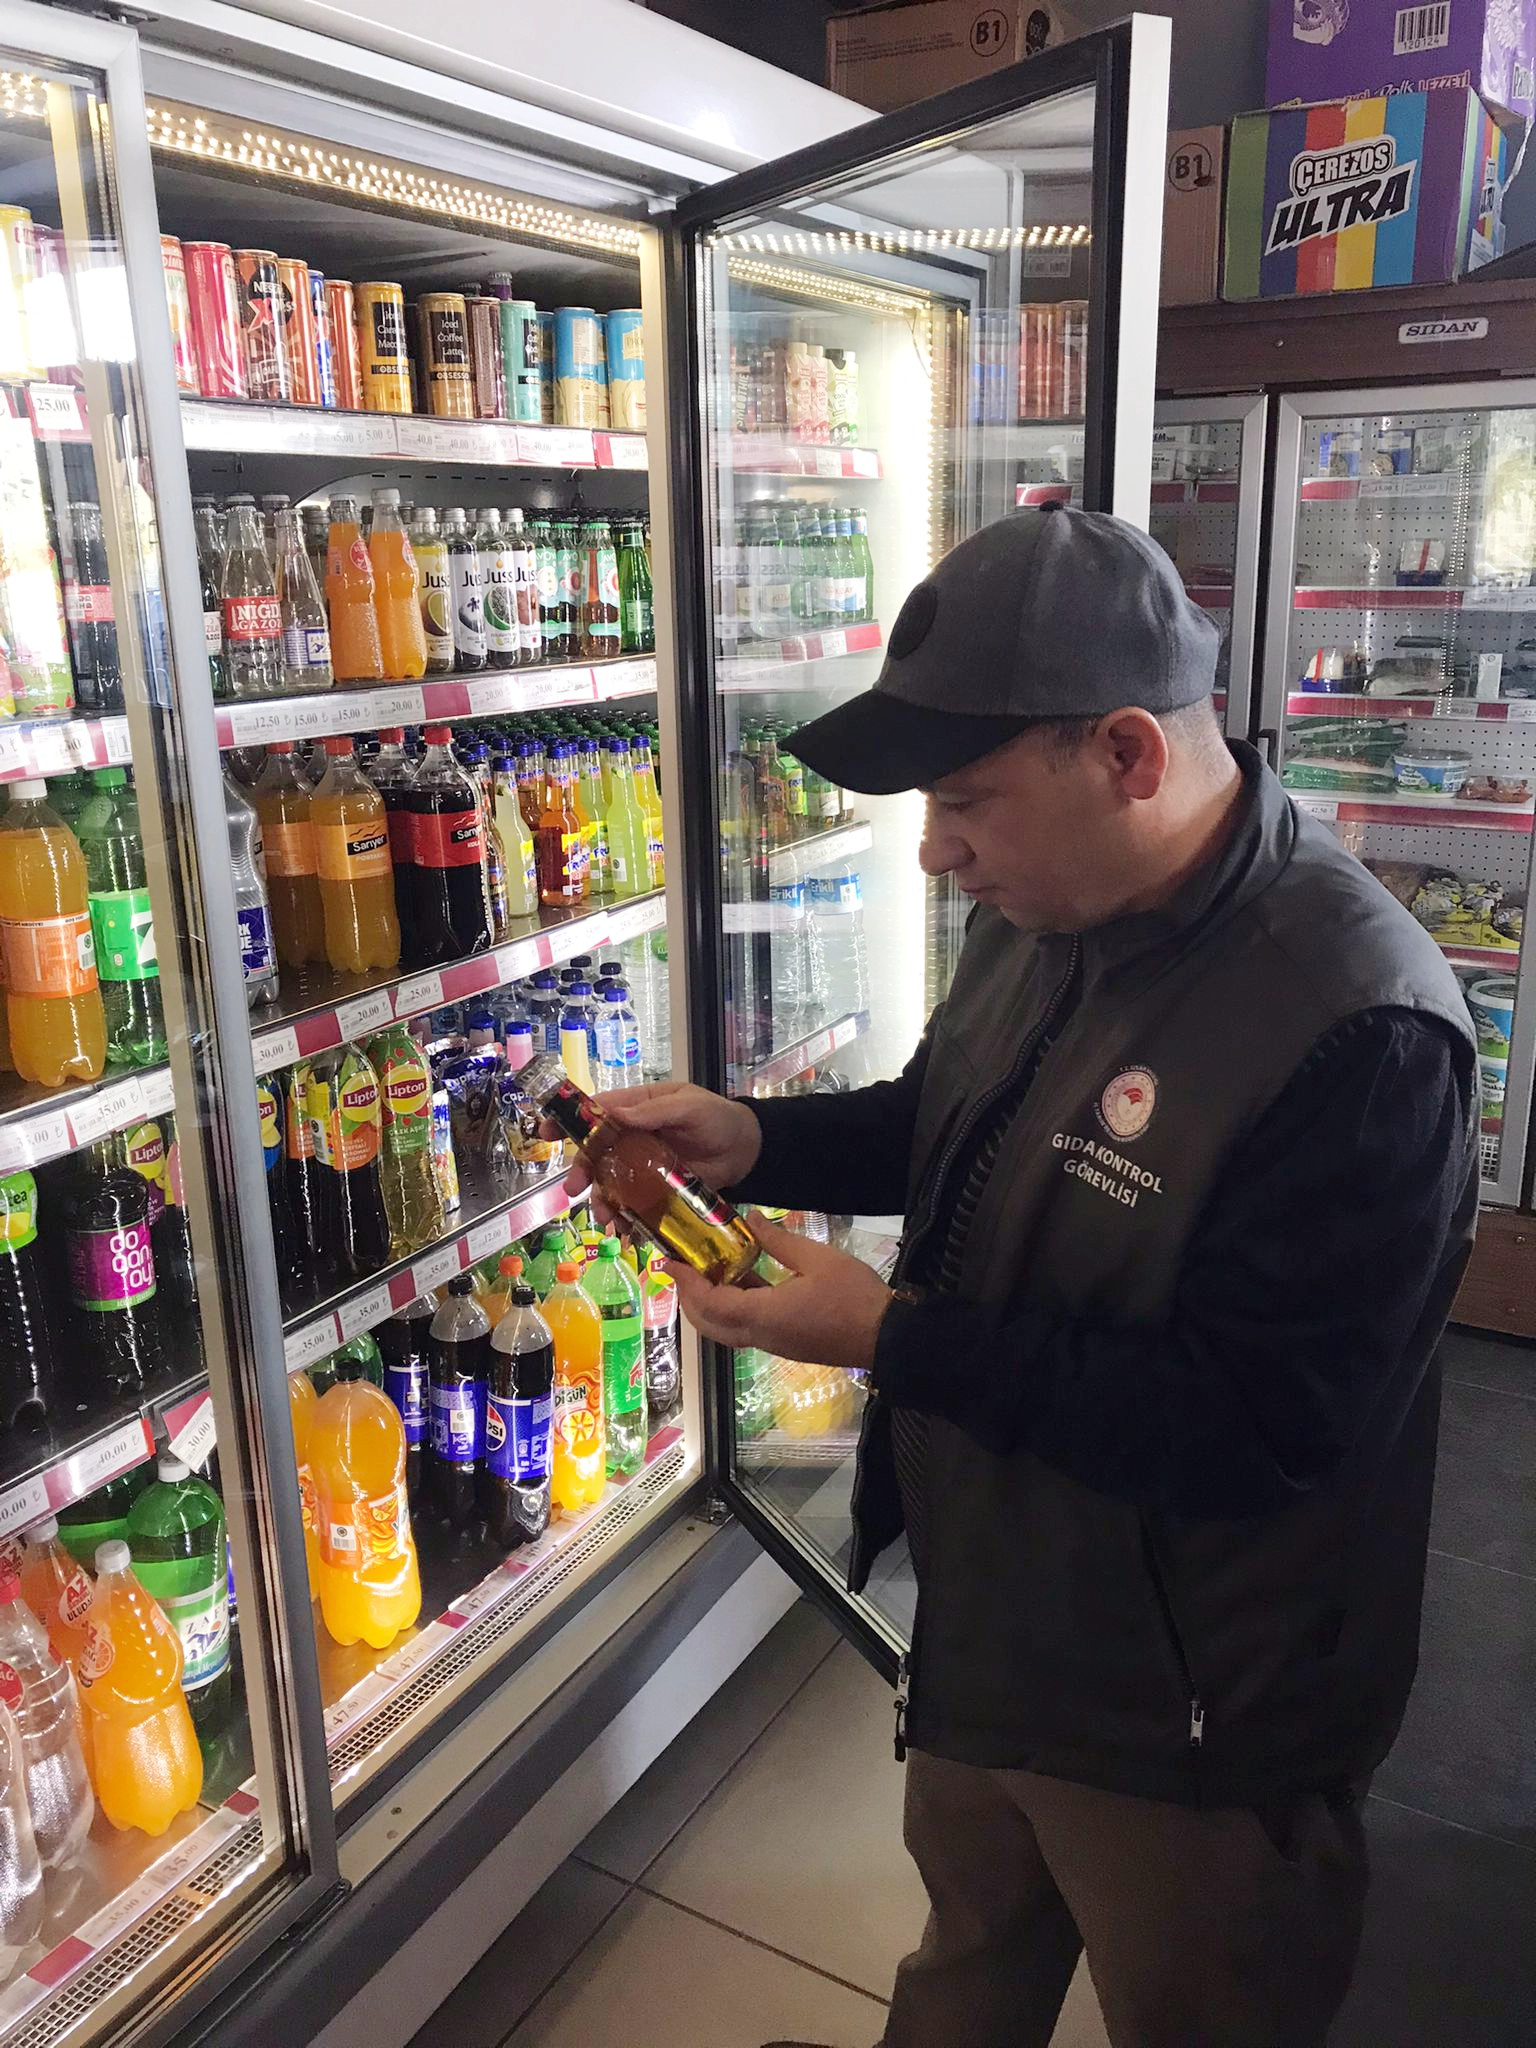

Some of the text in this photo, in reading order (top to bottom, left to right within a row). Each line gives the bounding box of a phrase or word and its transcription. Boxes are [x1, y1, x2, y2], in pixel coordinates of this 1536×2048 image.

[975, 20, 1002, 45] B1
[1295, 142, 1393, 197] ÇEREZOS
[1271, 168, 1412, 250] ULTRA
[1405, 320, 1479, 338] SIDAN
[388, 1081, 425, 1097] Lipton
[1063, 1158, 1139, 1208] GÖREVLİSİ
